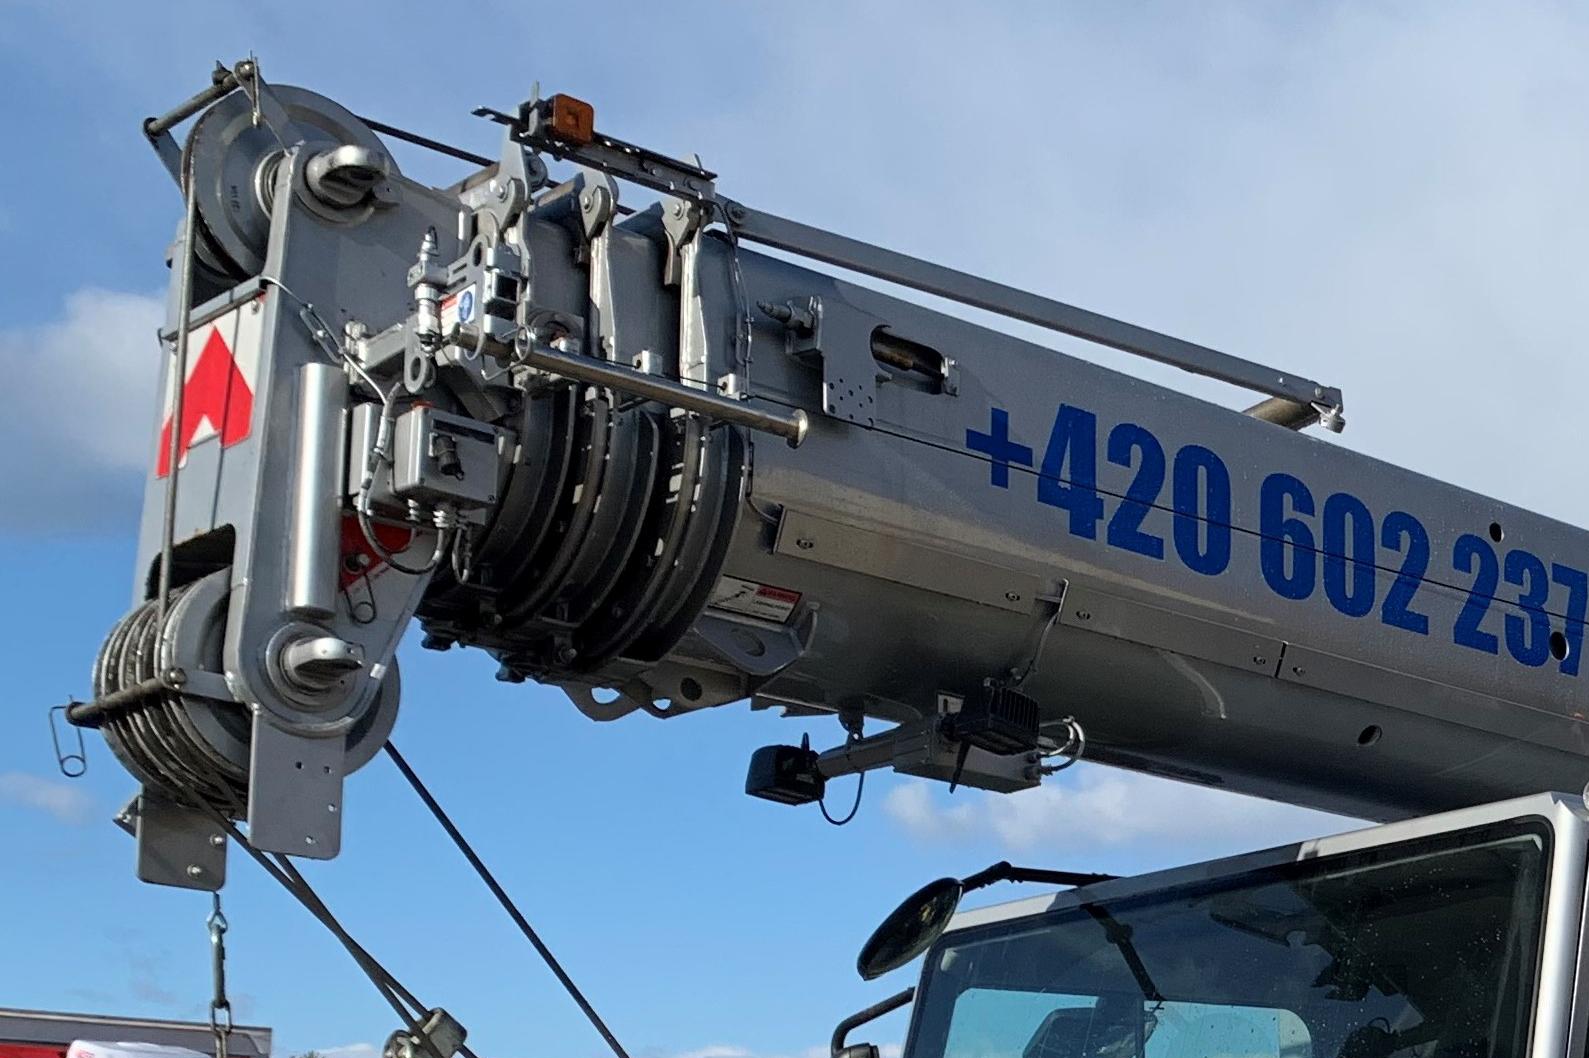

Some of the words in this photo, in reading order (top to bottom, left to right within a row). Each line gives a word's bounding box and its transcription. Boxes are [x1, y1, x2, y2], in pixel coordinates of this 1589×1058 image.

[966, 403, 1232, 576] +420
[1259, 472, 1430, 634] 602
[1452, 533, 1589, 677] 237
